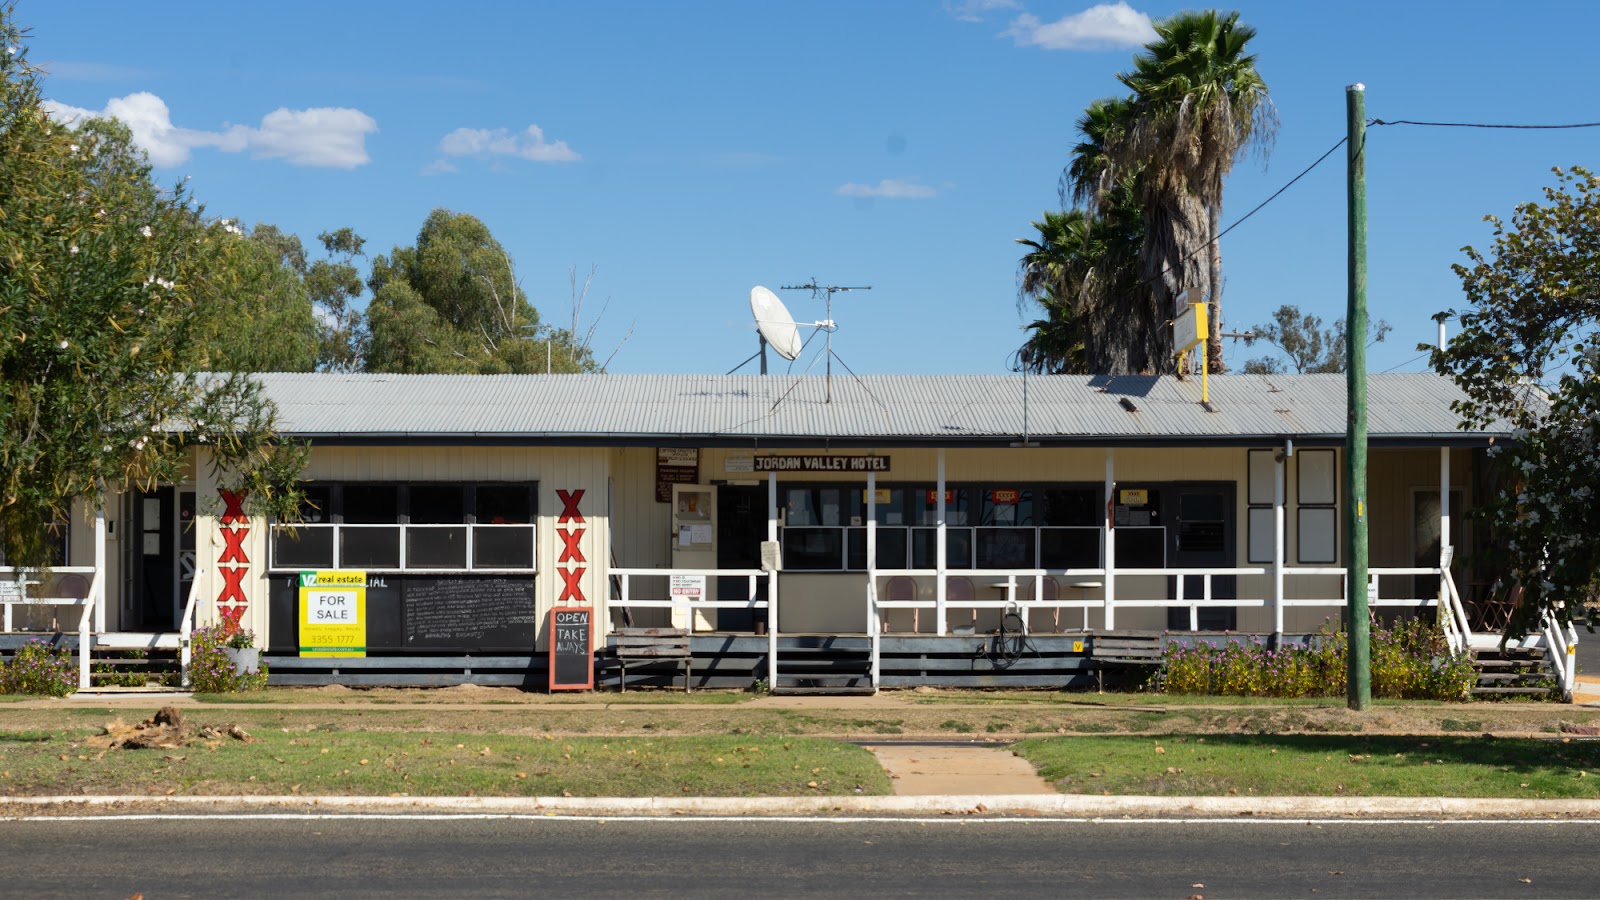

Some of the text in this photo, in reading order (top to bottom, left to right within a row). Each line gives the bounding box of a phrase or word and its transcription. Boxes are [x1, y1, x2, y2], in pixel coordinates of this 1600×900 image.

[756, 457, 801, 469] JORDAN
[803, 457, 848, 469] VALLEY
[851, 457, 886, 469] HOTEL
[302, 574, 316, 586] VZ
[318, 575, 334, 583] real
[319, 596, 345, 605] FOR
[317, 610, 348, 619] SALE
[557, 612, 588, 623] OPEN
[312, 635, 355, 643] 3355 1777
[558, 629, 587, 641] TAKE
[557, 642, 586, 654] AWAYS
